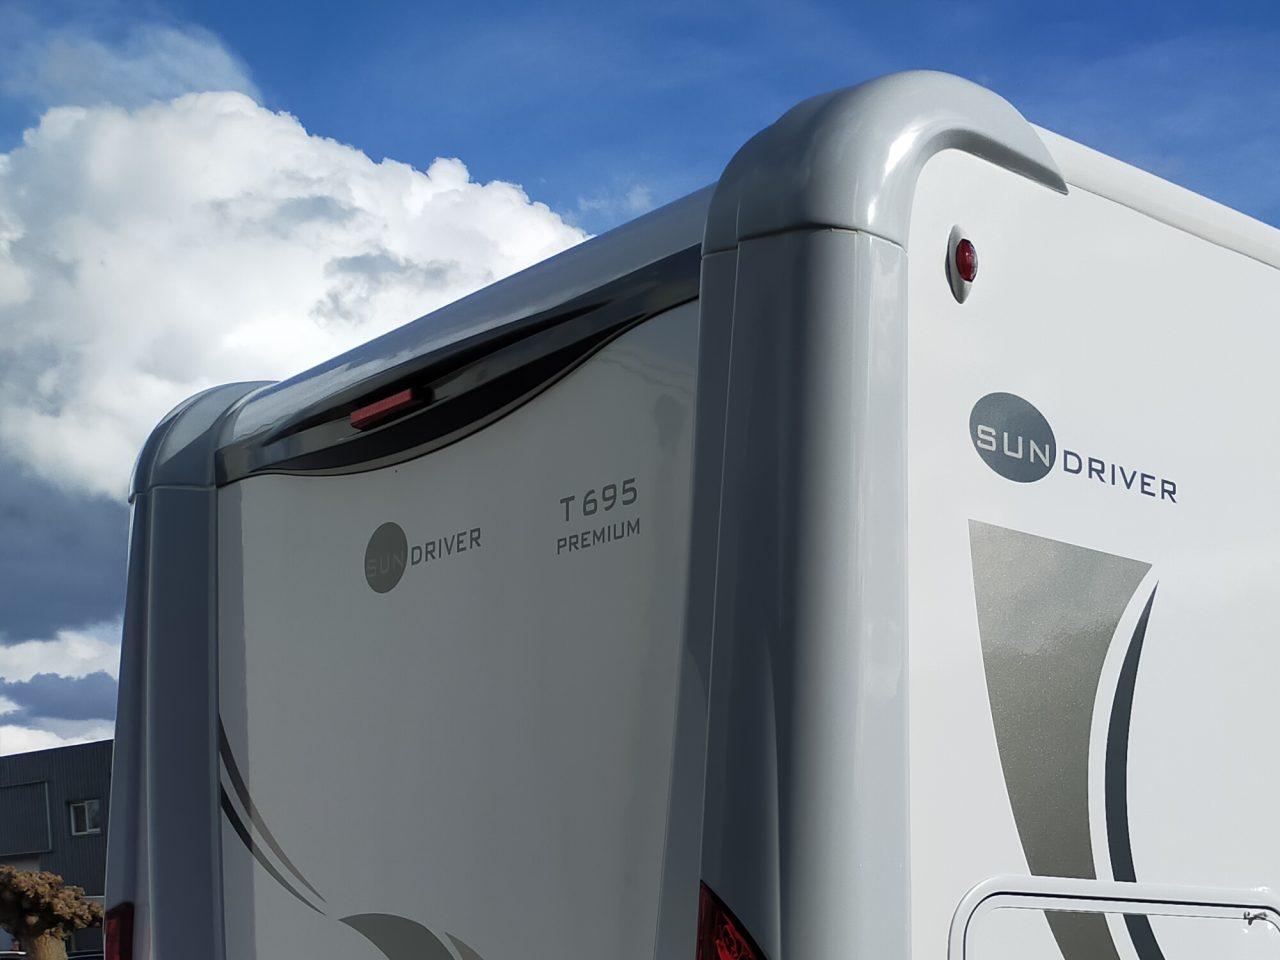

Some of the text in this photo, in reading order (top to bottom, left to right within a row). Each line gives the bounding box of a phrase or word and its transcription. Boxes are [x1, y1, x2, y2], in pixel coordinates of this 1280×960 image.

[976, 424, 1178, 503] SUN DRIVER
[560, 477, 637, 521] T 695
[411, 527, 482, 566] DRIVER
[557, 517, 640, 555] PREMIUM
